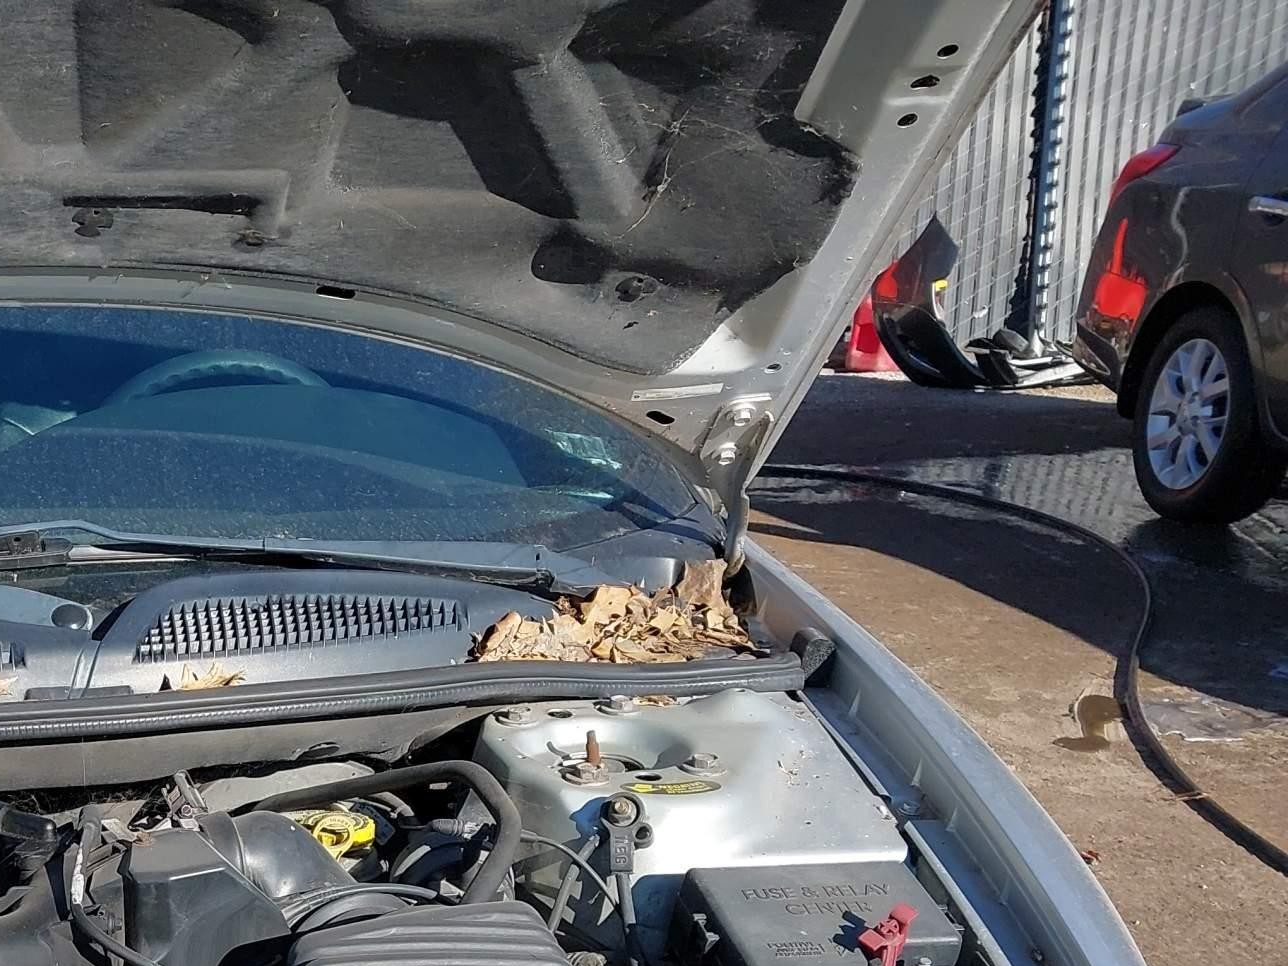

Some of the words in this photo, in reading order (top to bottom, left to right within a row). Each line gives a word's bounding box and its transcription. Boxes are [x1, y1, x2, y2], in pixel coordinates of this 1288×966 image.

[742, 886, 793, 900] FUSE
[801, 886, 817, 898] &
[822, 883, 890, 897] RELAY
[785, 901, 873, 916] CENTER
